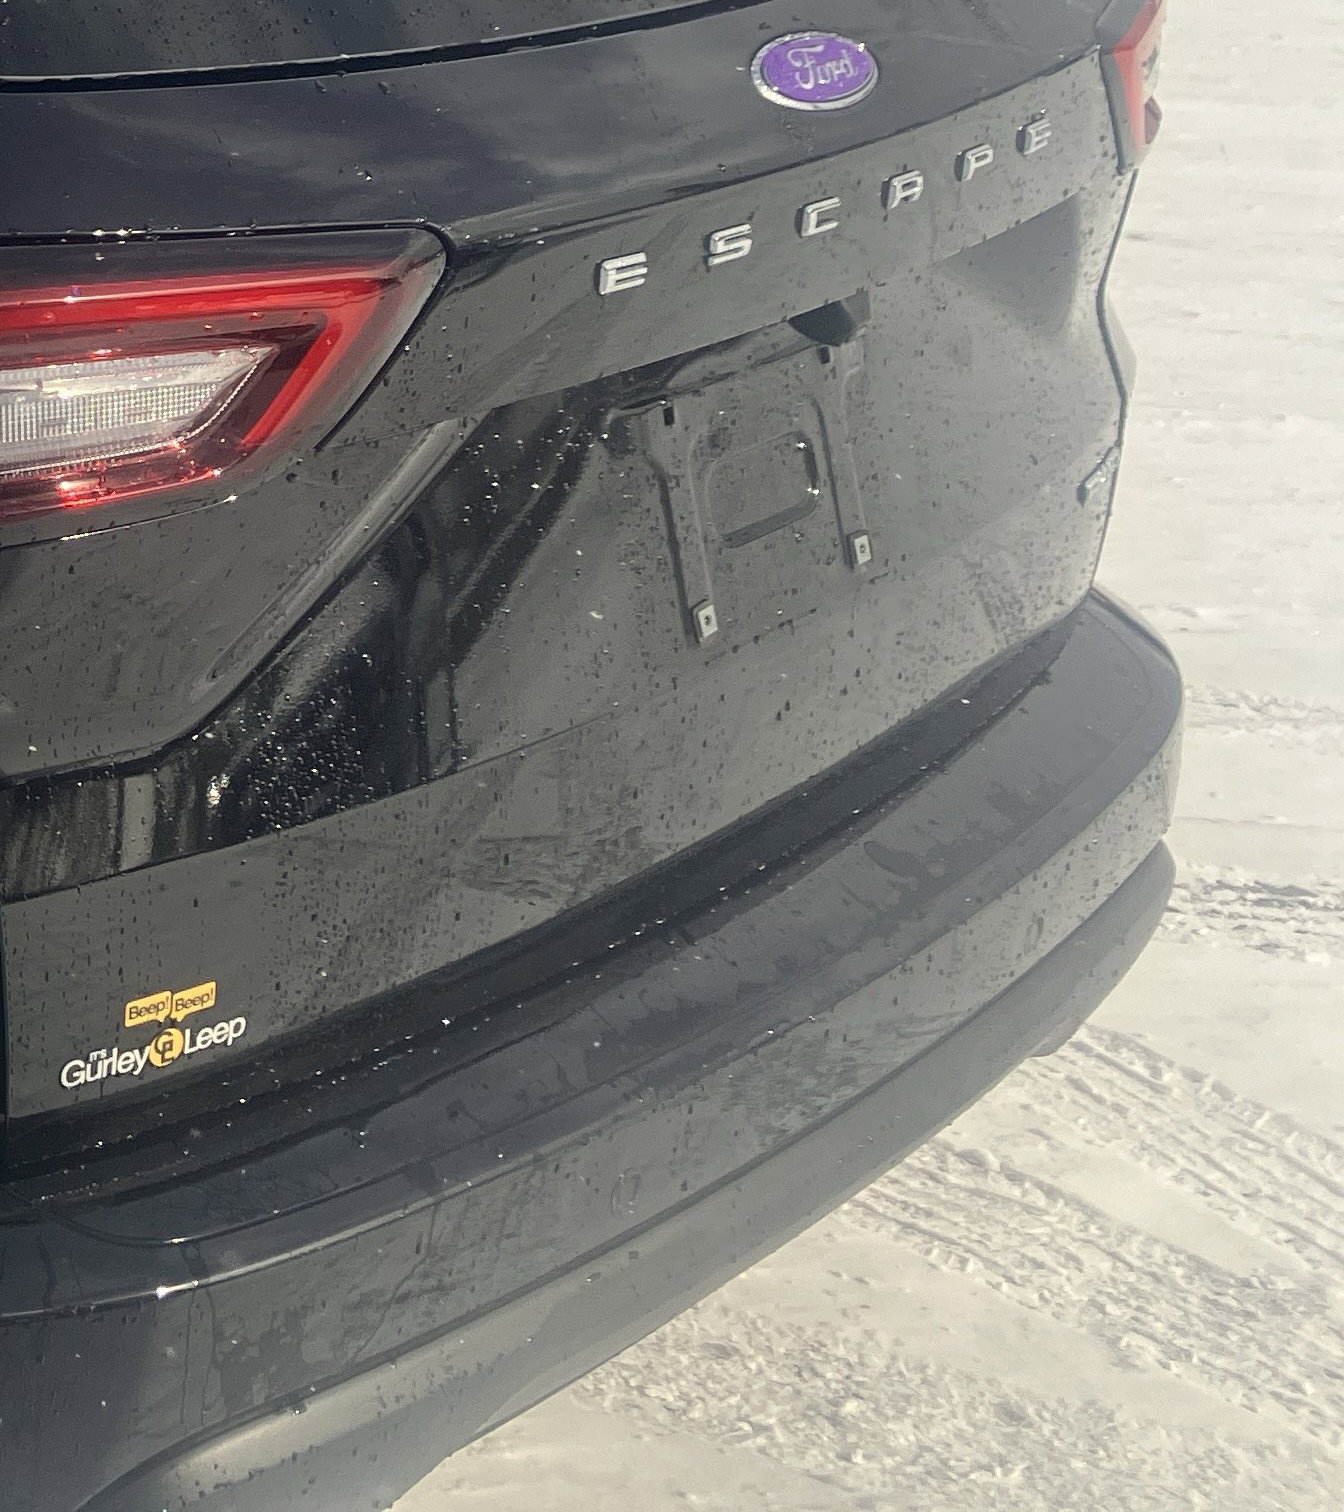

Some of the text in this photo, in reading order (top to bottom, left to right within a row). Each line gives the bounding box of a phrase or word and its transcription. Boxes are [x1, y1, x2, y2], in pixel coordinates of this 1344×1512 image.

[787, 44, 860, 90] Ford
[596, 116, 1053, 296] ESCAPE
[128, 989, 214, 1020] Beep! Beep!
[61, 1047, 150, 1088] Gurley
[184, 1016, 247, 1054] Leep
